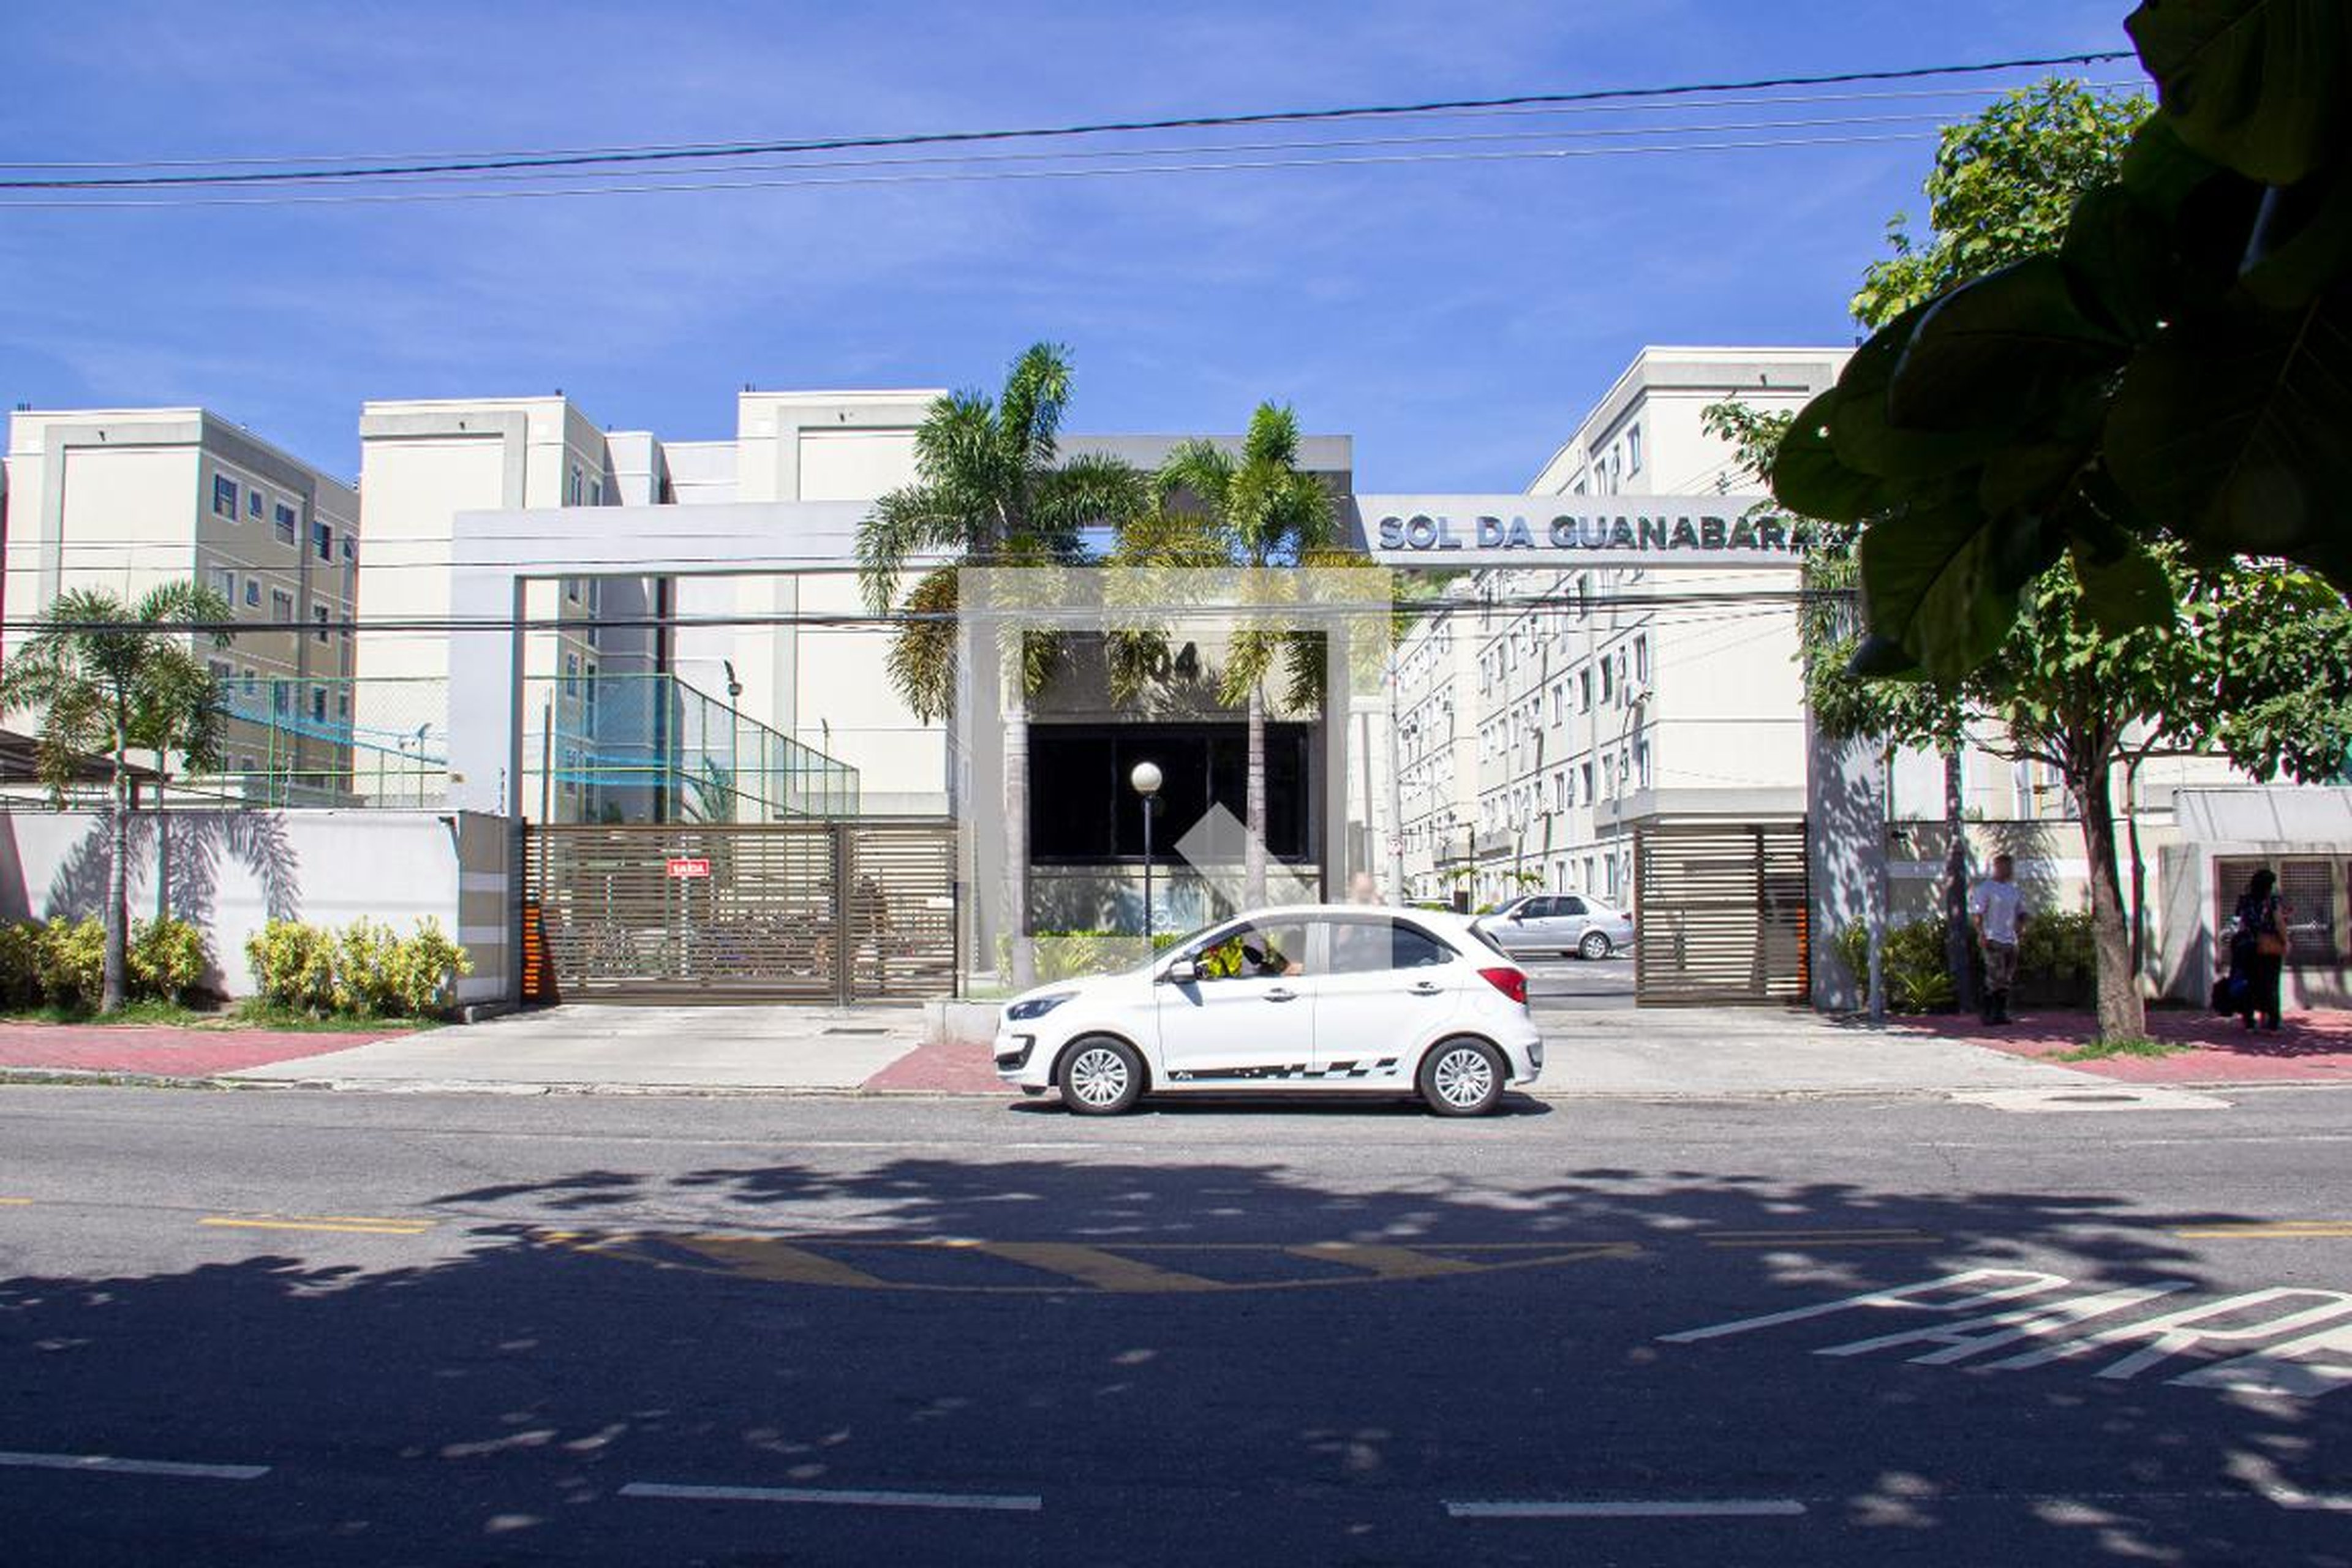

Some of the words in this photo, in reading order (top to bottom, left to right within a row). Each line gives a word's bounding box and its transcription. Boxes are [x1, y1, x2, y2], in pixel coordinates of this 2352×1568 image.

[1379, 514, 1462, 549] SOL
[1477, 516, 1535, 549] DA
[1143, 911, 1178, 925] OL
